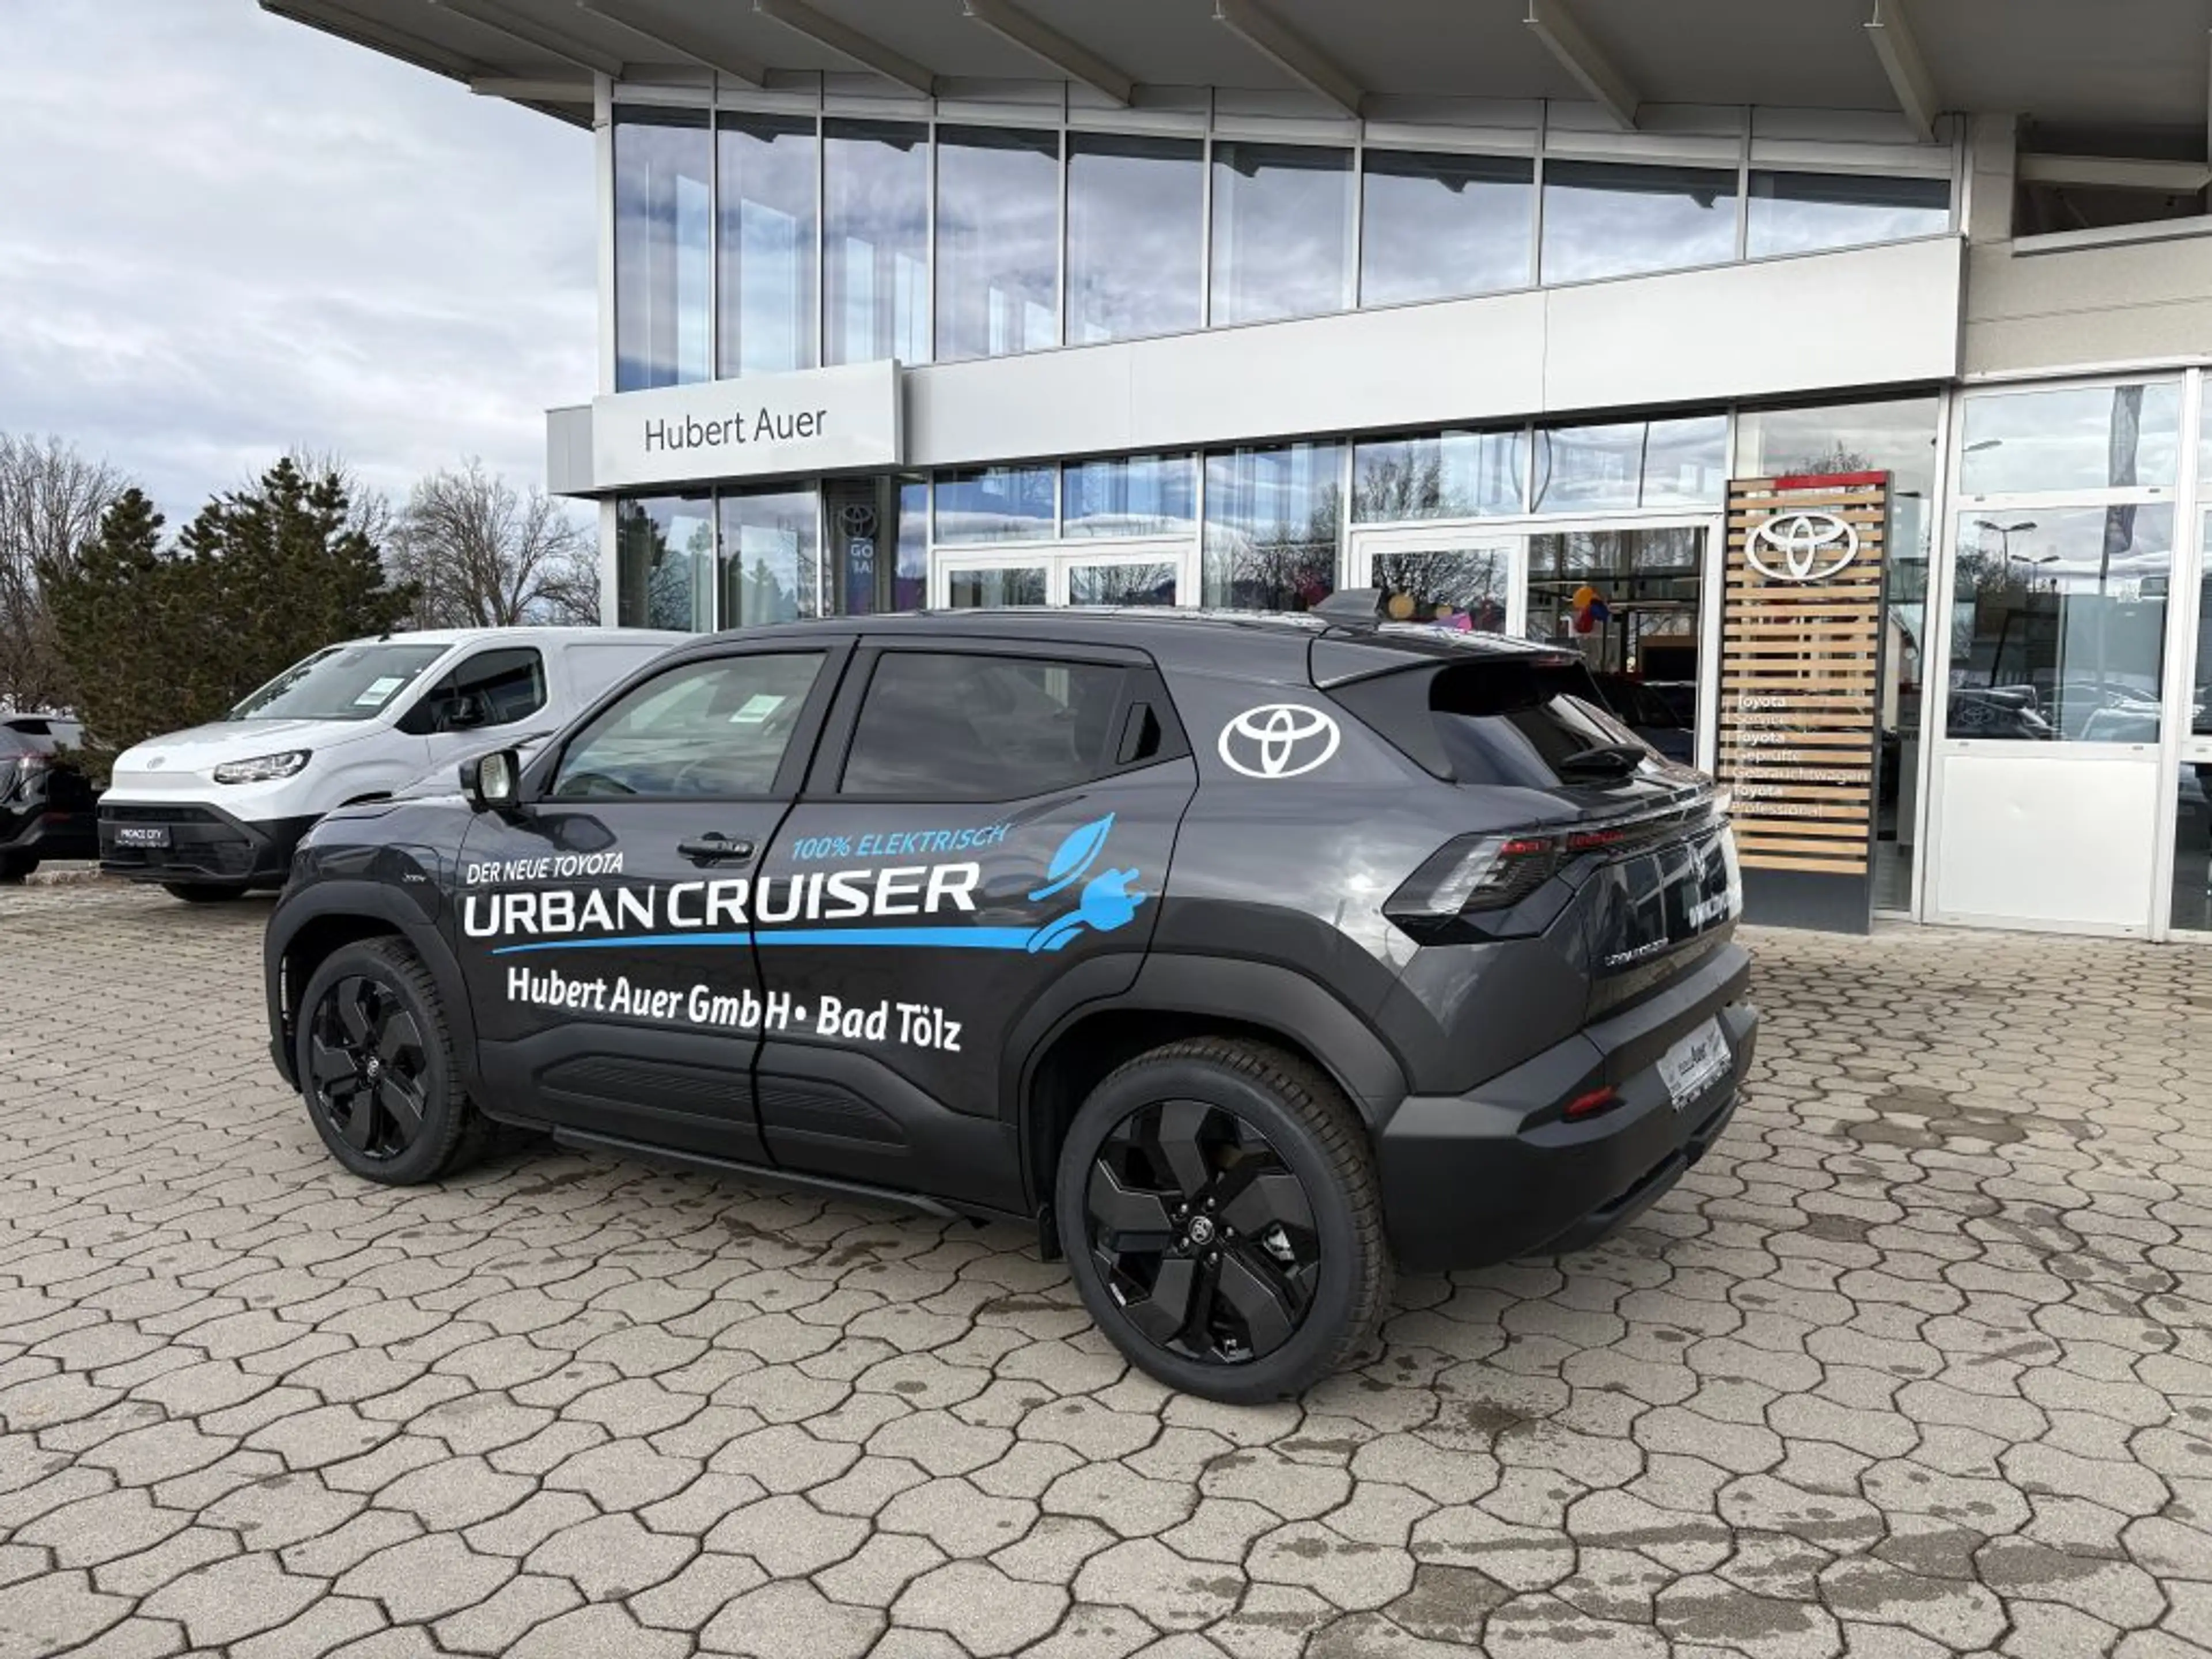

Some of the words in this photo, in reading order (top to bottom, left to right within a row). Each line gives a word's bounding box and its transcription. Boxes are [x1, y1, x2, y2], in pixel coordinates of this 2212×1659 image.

[645, 412, 746, 452] Hubert
[753, 407, 827, 441] Auer
[1738, 694, 1786, 710] Toyota
[1736, 731, 1785, 747] Toyota
[1733, 784, 1783, 798] Toyota
[792, 836, 850, 859] 100%
[856, 824, 1010, 857] ELEKTRISCH
[467, 863, 499, 884] DER
[503, 859, 549, 882] NEUE
[553, 853, 624, 877] TOYOTA
[464, 885, 656, 936] URBAN
[667, 862, 980, 927] CRUISER
[507, 967, 606, 1011] Hubert
[609, 976, 683, 1019] Auer
[817, 996, 888, 1041] Bad
[896, 1002, 963, 1052] Tölz
